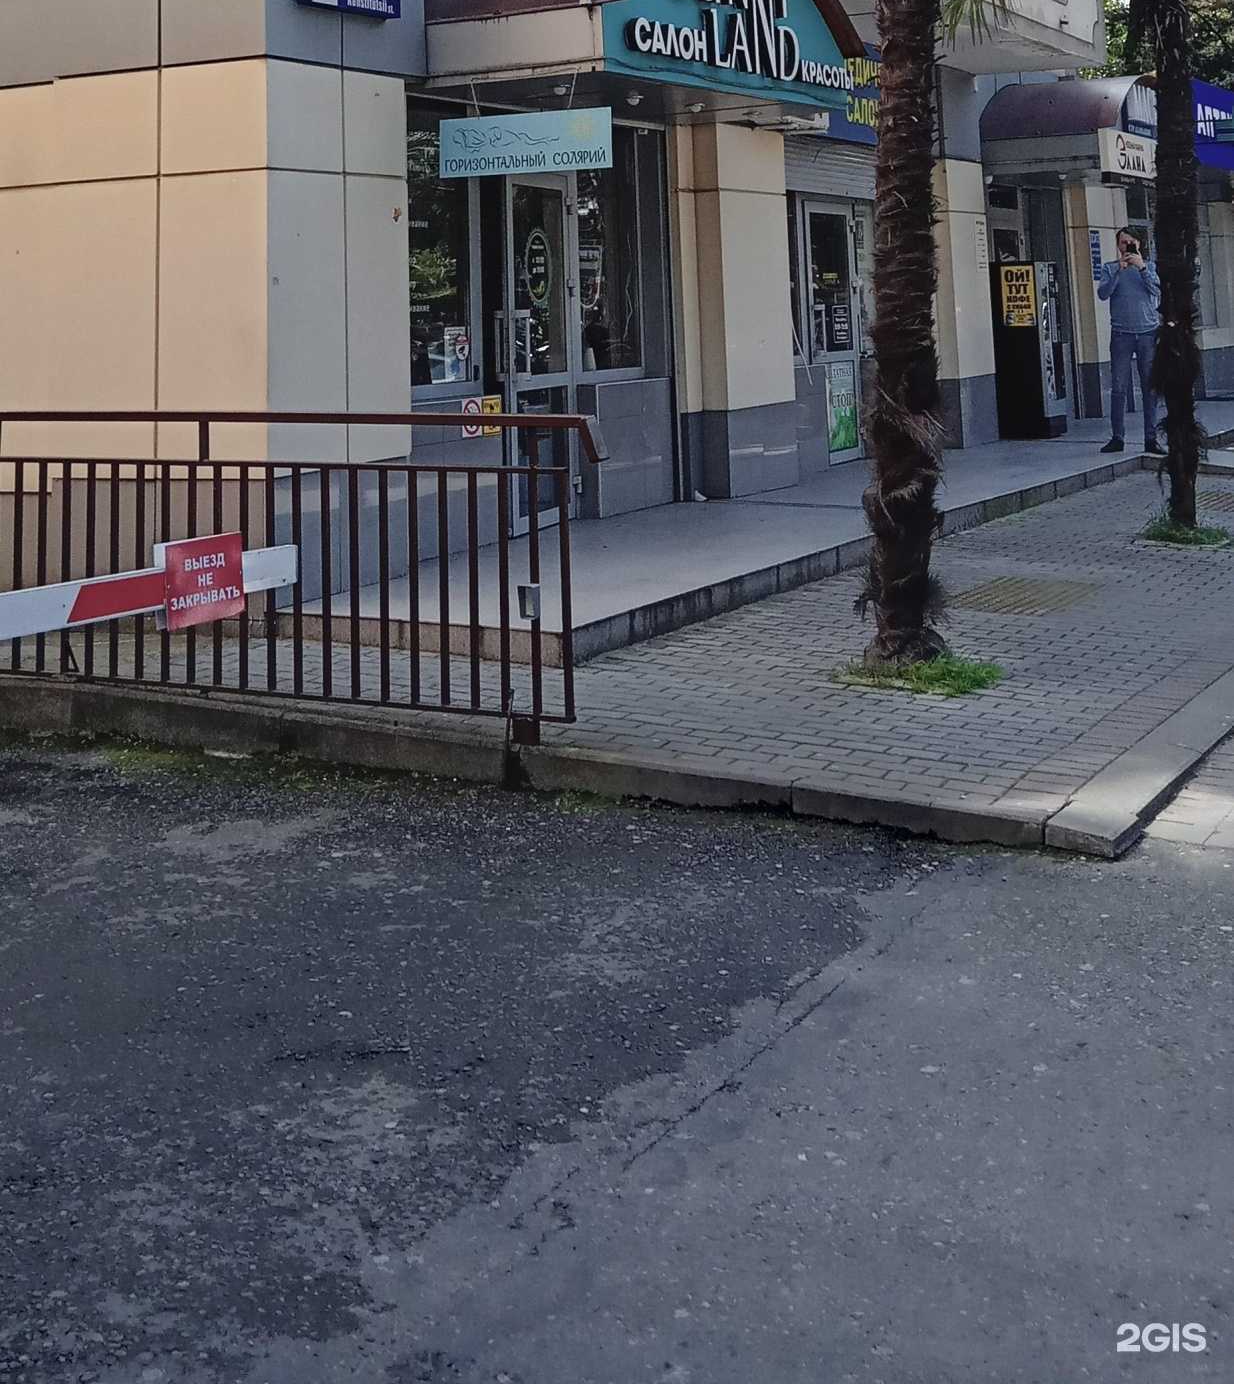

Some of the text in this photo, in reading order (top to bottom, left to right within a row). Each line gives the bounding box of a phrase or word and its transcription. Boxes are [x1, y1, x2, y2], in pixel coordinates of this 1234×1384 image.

[635, 17, 707, 62] САЛОН
[711, 8, 800, 81] LAND
[801, 59, 854, 91] КРАСОТЫ
[844, 57, 881, 88] ЕДИЧ
[445, 146, 606, 173] ГОРИЗОНТАЛЬНЫЙ СОЛЯРИЙ
[1005, 268, 1030, 282] ОЙ!
[1007, 284, 1028, 294] ТУТ
[184, 553, 225, 571] ВЫЕЗД
[197, 572, 213, 587] НЕ
[171, 585, 240, 610] ЗАКРЫВАТЬ
